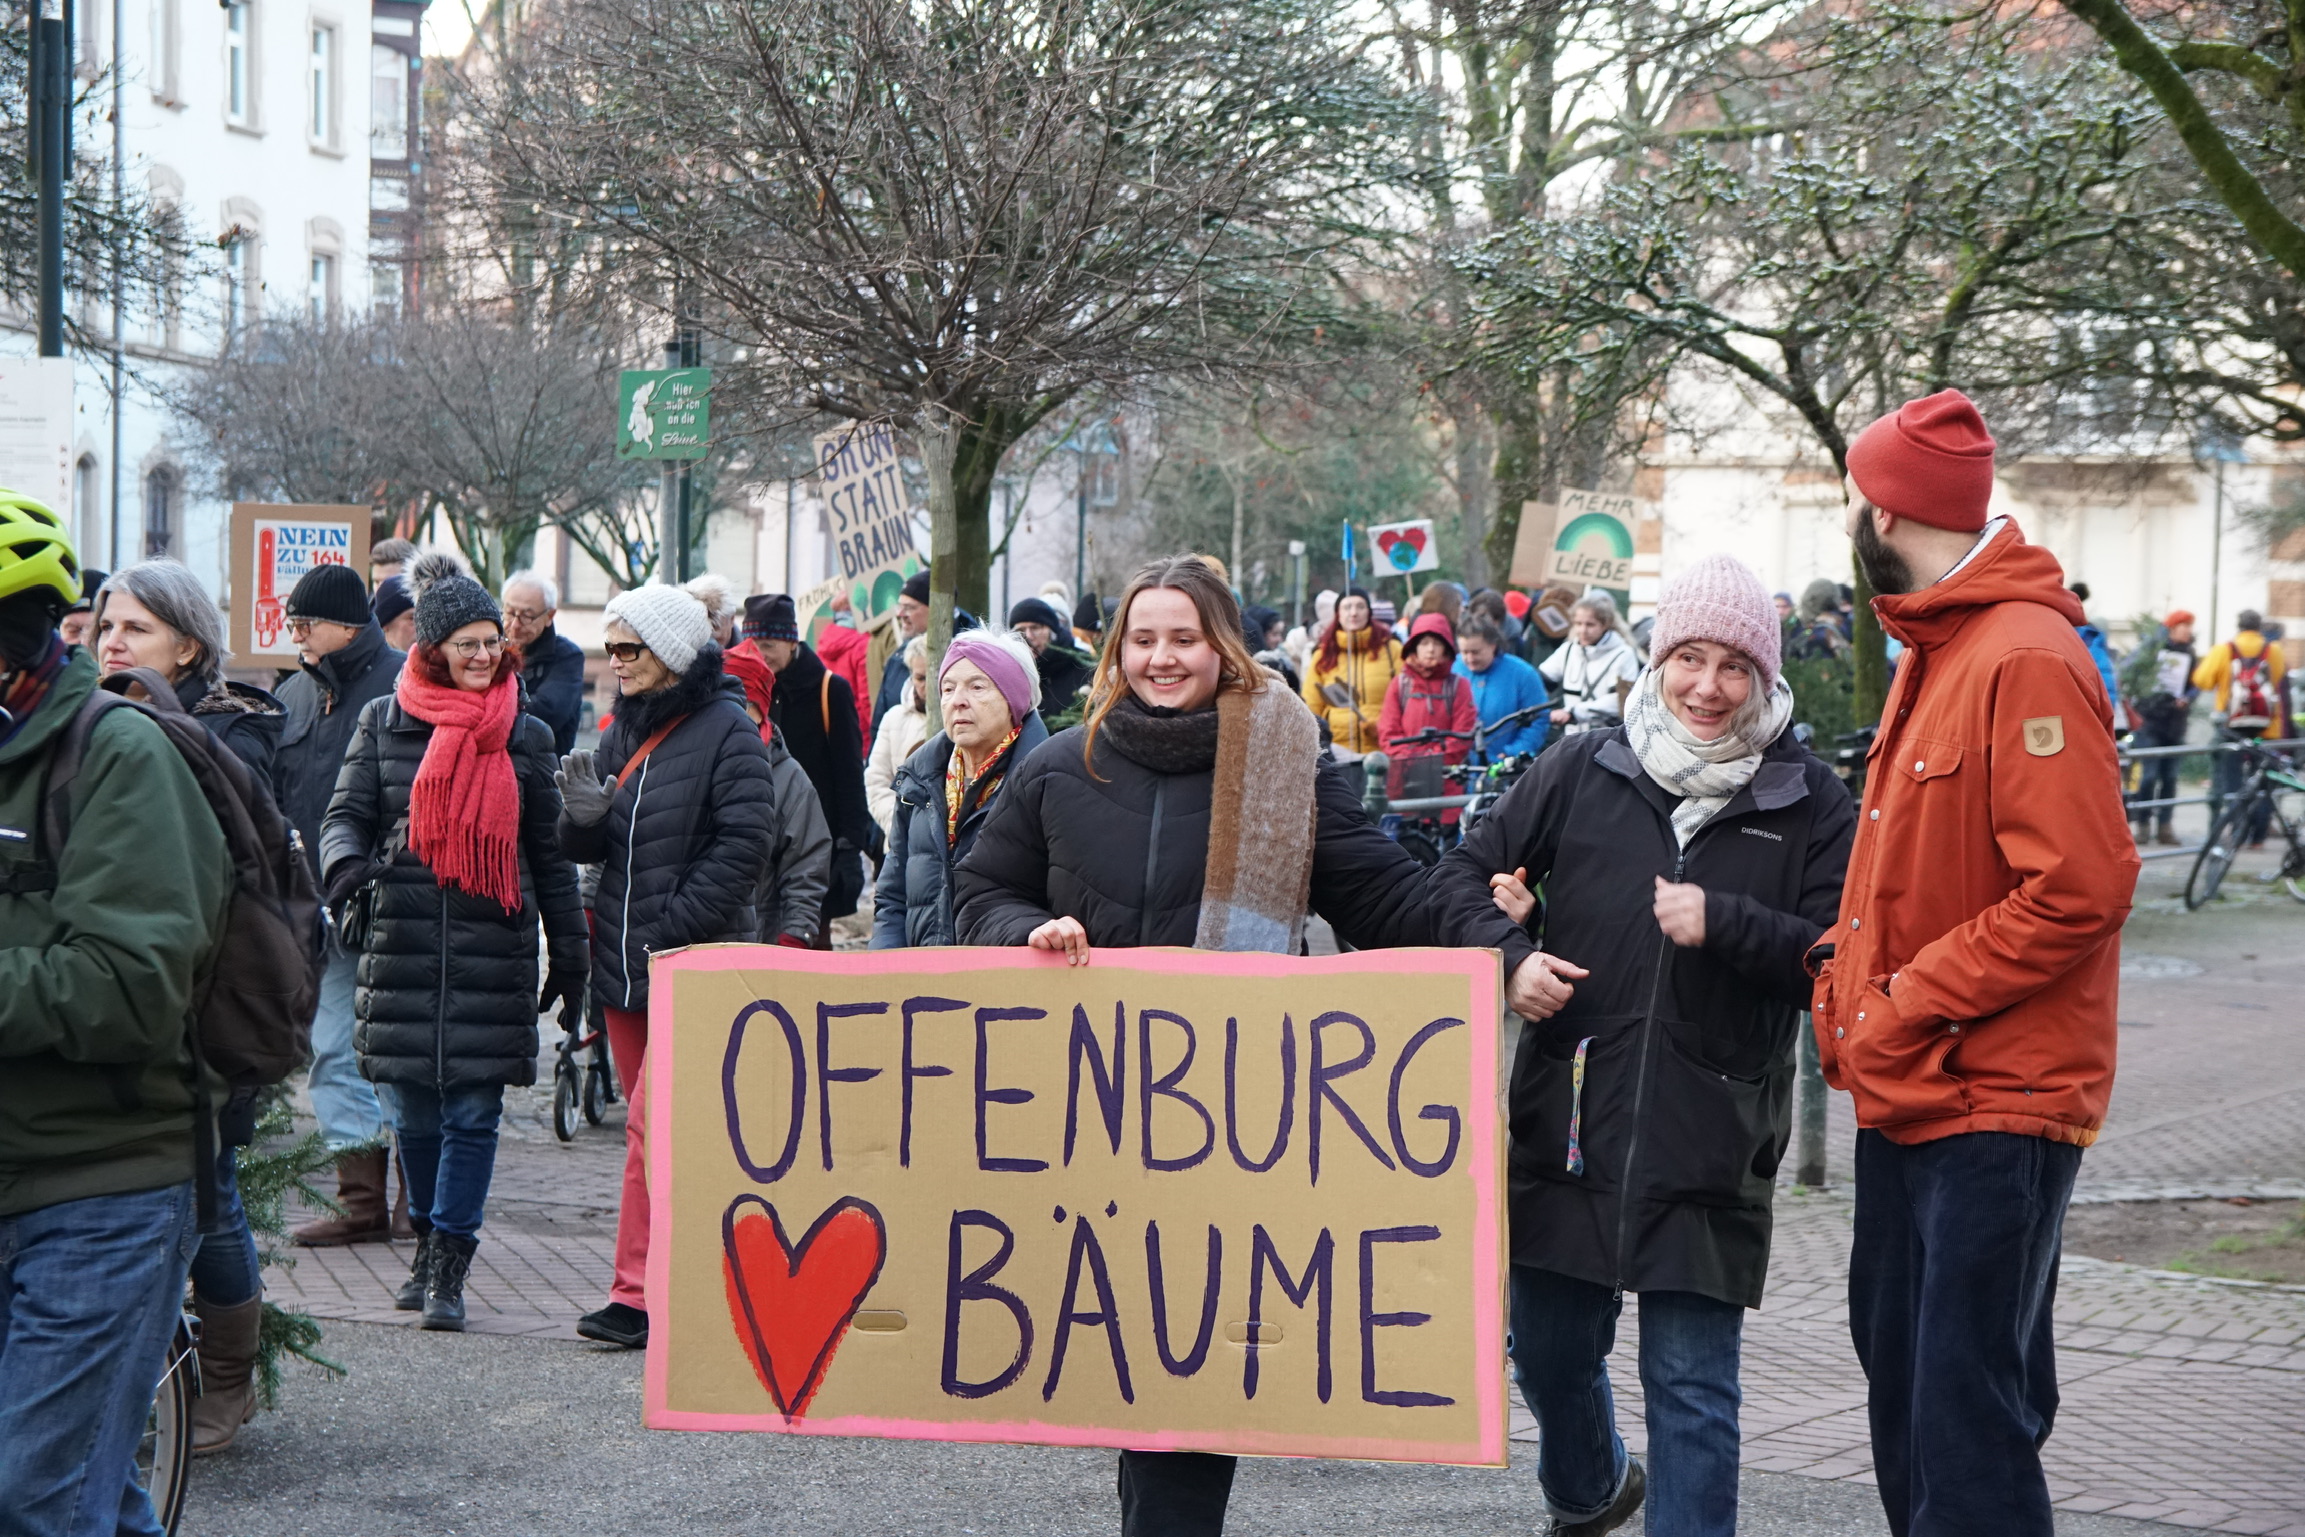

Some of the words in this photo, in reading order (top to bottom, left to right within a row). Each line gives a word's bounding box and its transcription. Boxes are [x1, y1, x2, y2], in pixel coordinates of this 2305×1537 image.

[672, 382, 694, 396] Hier
[667, 415, 679, 425] an
[681, 411, 695, 425] die
[831, 465, 895, 535] STATT
[1564, 492, 1636, 519] MEHR
[278, 526, 349, 547] NEIN
[839, 511, 915, 580] BRAUN
[277, 548, 306, 564] ZU
[311, 550, 346, 566] 164
[722, 996, 1465, 1187] OFFENBURG
[941, 1199, 1456, 1406] BÄUME
